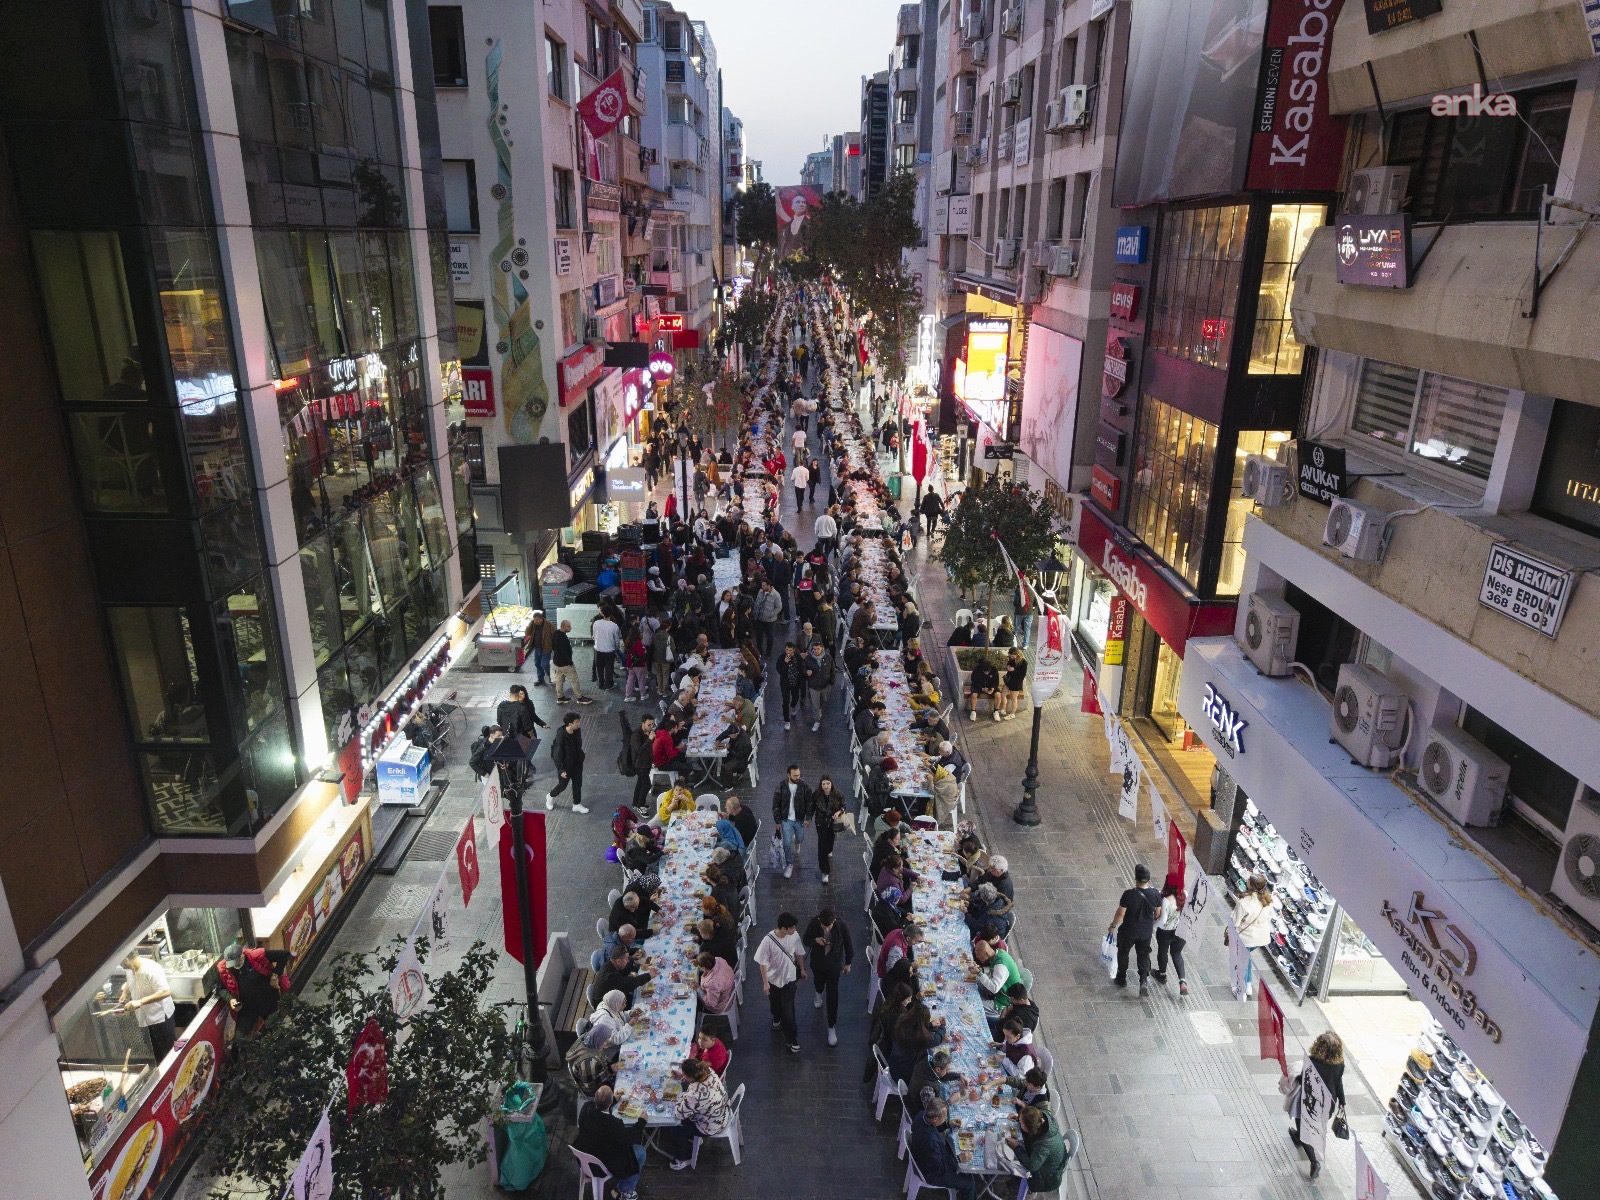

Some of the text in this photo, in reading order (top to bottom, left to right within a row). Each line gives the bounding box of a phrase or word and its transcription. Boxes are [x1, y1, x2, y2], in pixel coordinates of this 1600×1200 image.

[1268, 49, 1282, 85] SEVEN
[1116, 230, 1140, 256] mavi
[1301, 464, 1339, 491] AVUKAT
[1102, 539, 1147, 611] Kasaba
[1493, 553, 1514, 577] DİŞ
[1486, 575, 1513, 596] Neşe
[1486, 591, 1509, 608] 368
[1512, 603, 1529, 618] 85
[1112, 599, 1127, 639] Kasaba
[1202, 682, 1249, 753] RENK
[1421, 973, 1430, 990] &
